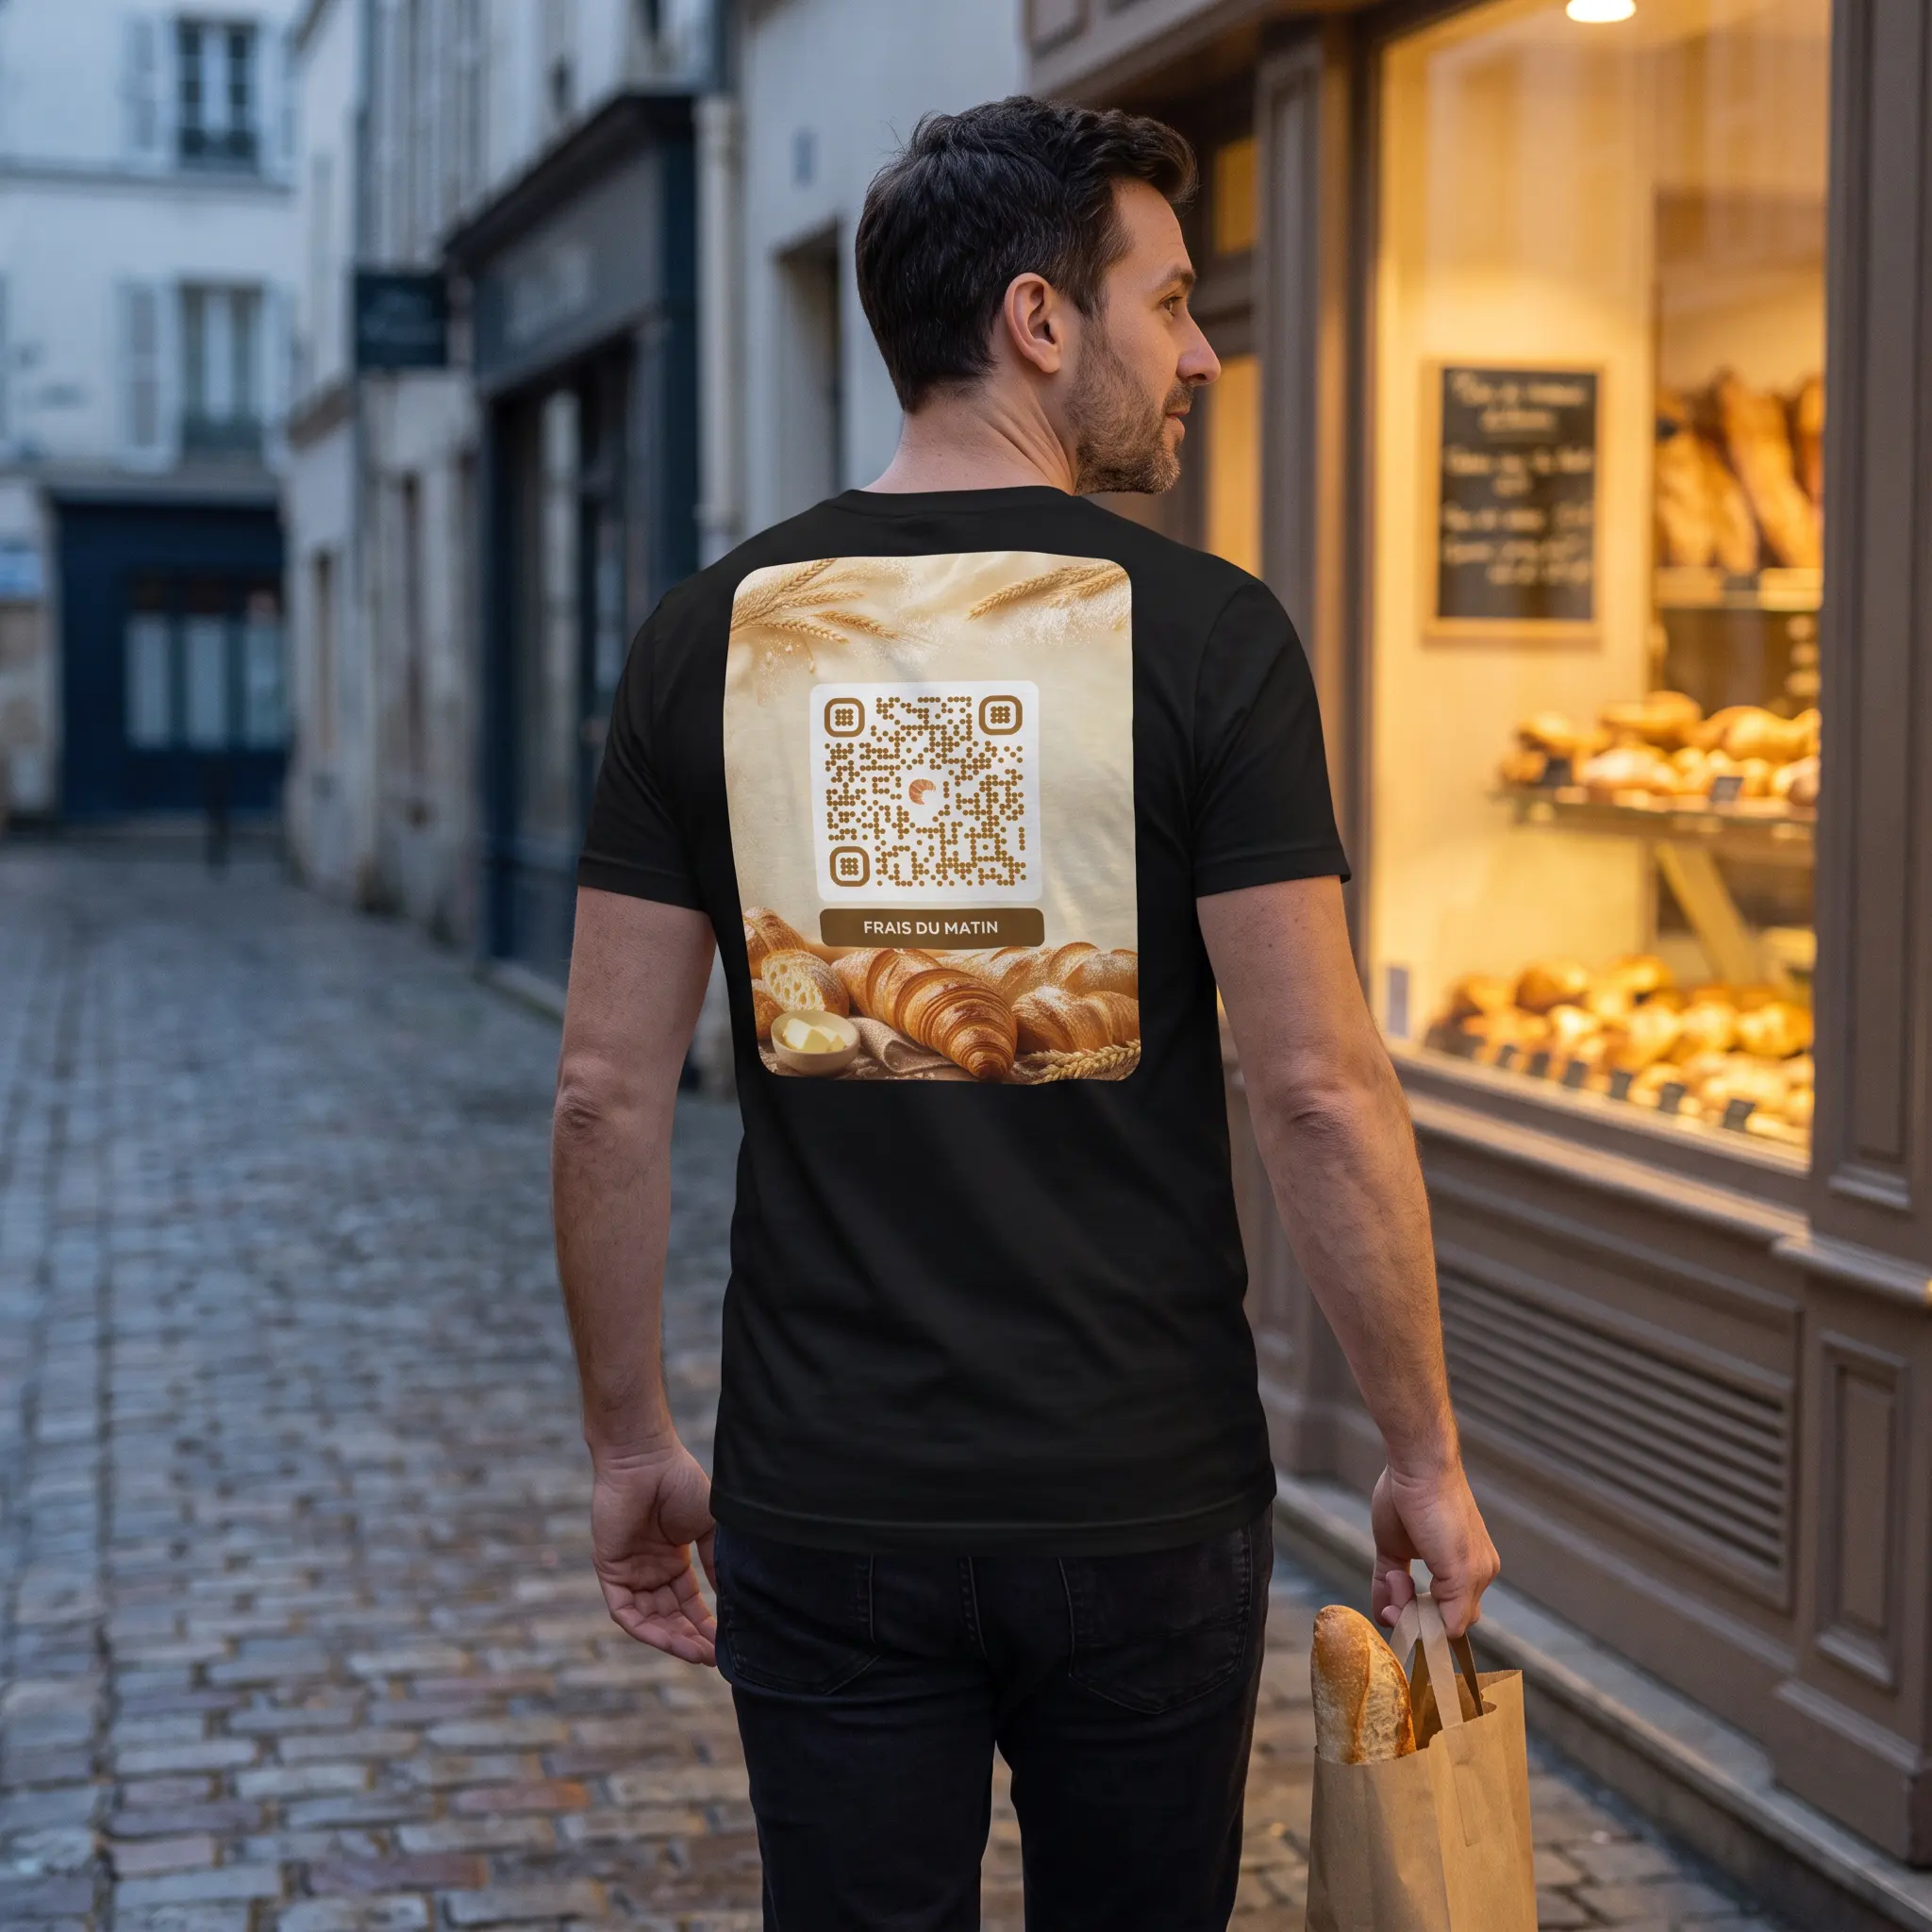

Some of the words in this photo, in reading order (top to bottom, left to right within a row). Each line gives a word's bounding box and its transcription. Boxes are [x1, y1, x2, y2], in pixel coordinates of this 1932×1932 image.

[863, 921, 910, 934] FRAIS
[916, 922, 940, 935] DU
[944, 921, 998, 935] MATIN
